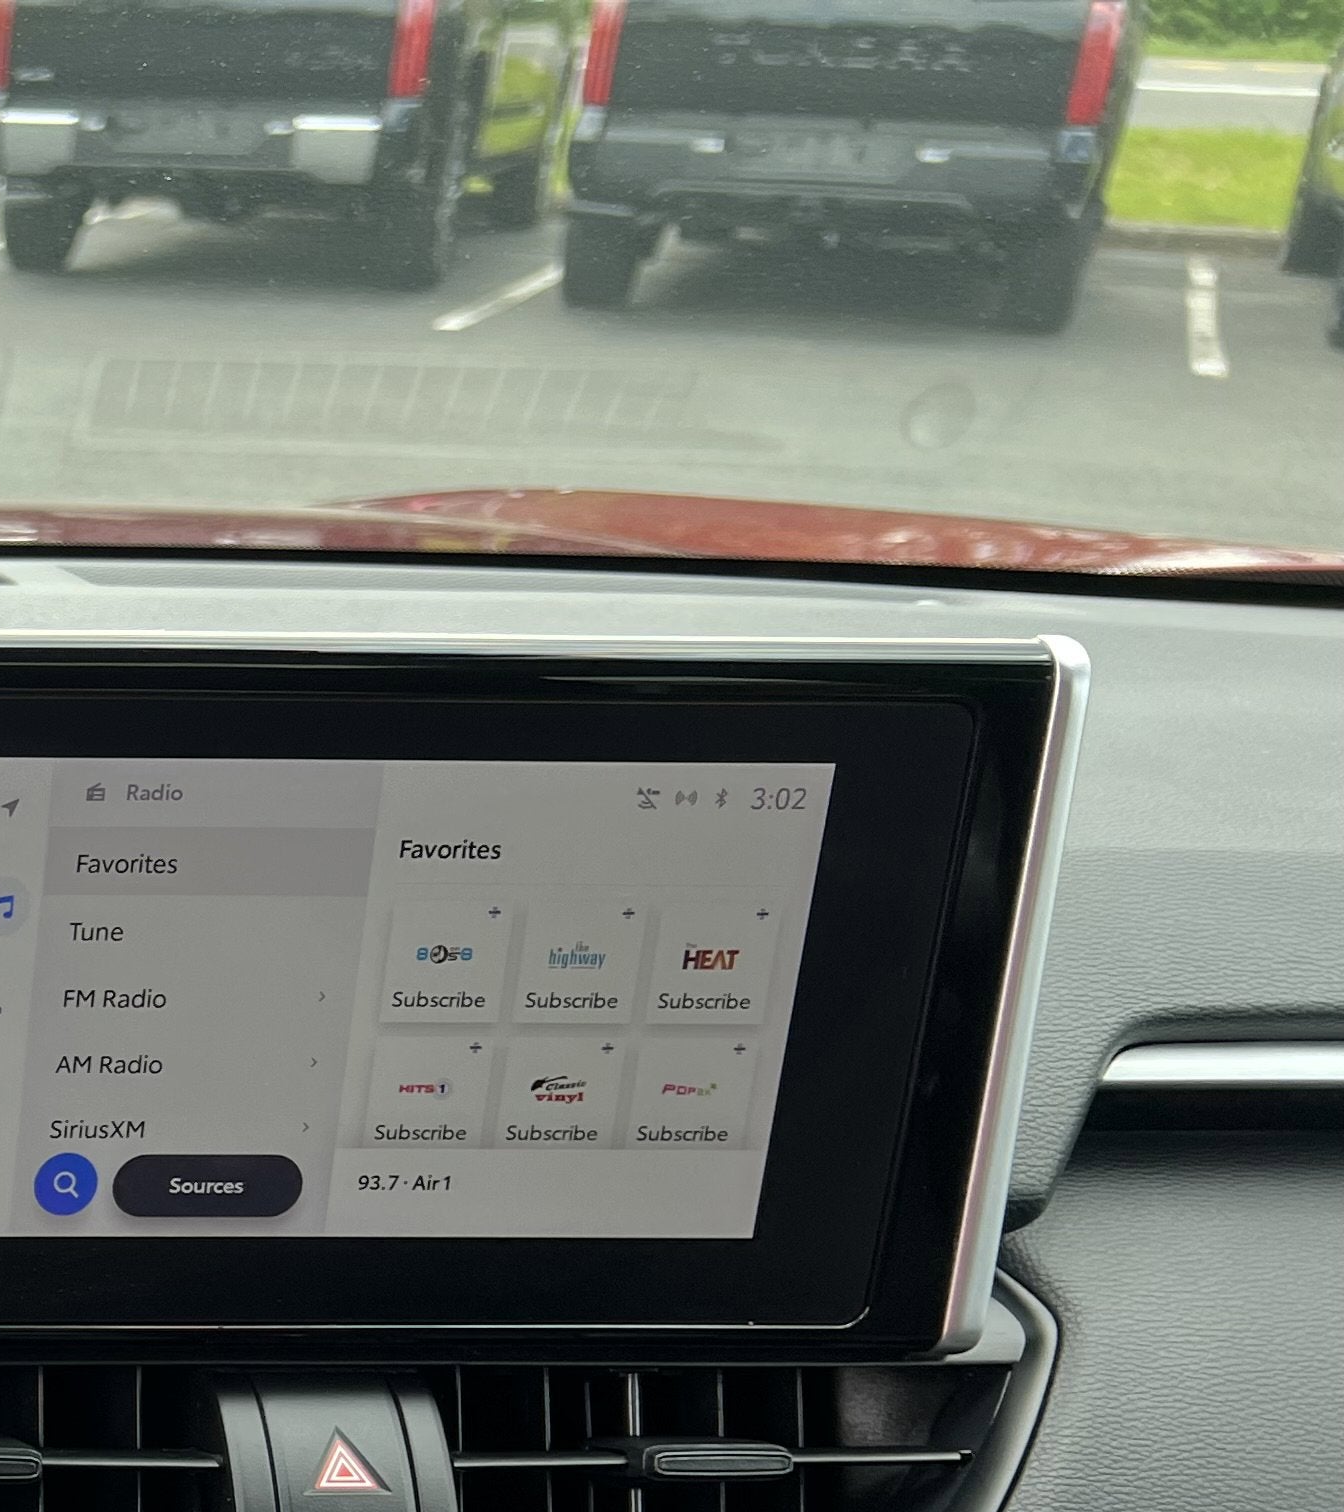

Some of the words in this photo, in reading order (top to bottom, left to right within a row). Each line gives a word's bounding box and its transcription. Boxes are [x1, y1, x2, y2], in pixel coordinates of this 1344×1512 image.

[127, 784, 183, 800] Radio
[751, 788, 806, 810] 3:02
[400, 840, 501, 859] Favorites
[77, 854, 177, 873] Favorites
[70, 923, 123, 941] Tune
[548, 948, 608, 969] highway
[682, 949, 740, 970] HEAT
[64, 990, 95, 1007] FM
[103, 989, 166, 1008] Radio
[392, 991, 485, 1007] Subscribe
[525, 992, 618, 1008] Subscribe
[658, 993, 750, 1009] Subscribe
[56, 1056, 91, 1073] AM
[100, 1055, 162, 1074] Radio
[50, 1120, 145, 1138] SiriusXM
[375, 1125, 466, 1140] Subscribe
[506, 1125, 597, 1140] Subscribe
[637, 1126, 728, 1141] Subscribe
[169, 1178, 243, 1193] Sources
[359, 1175, 399, 1190] 93.7
